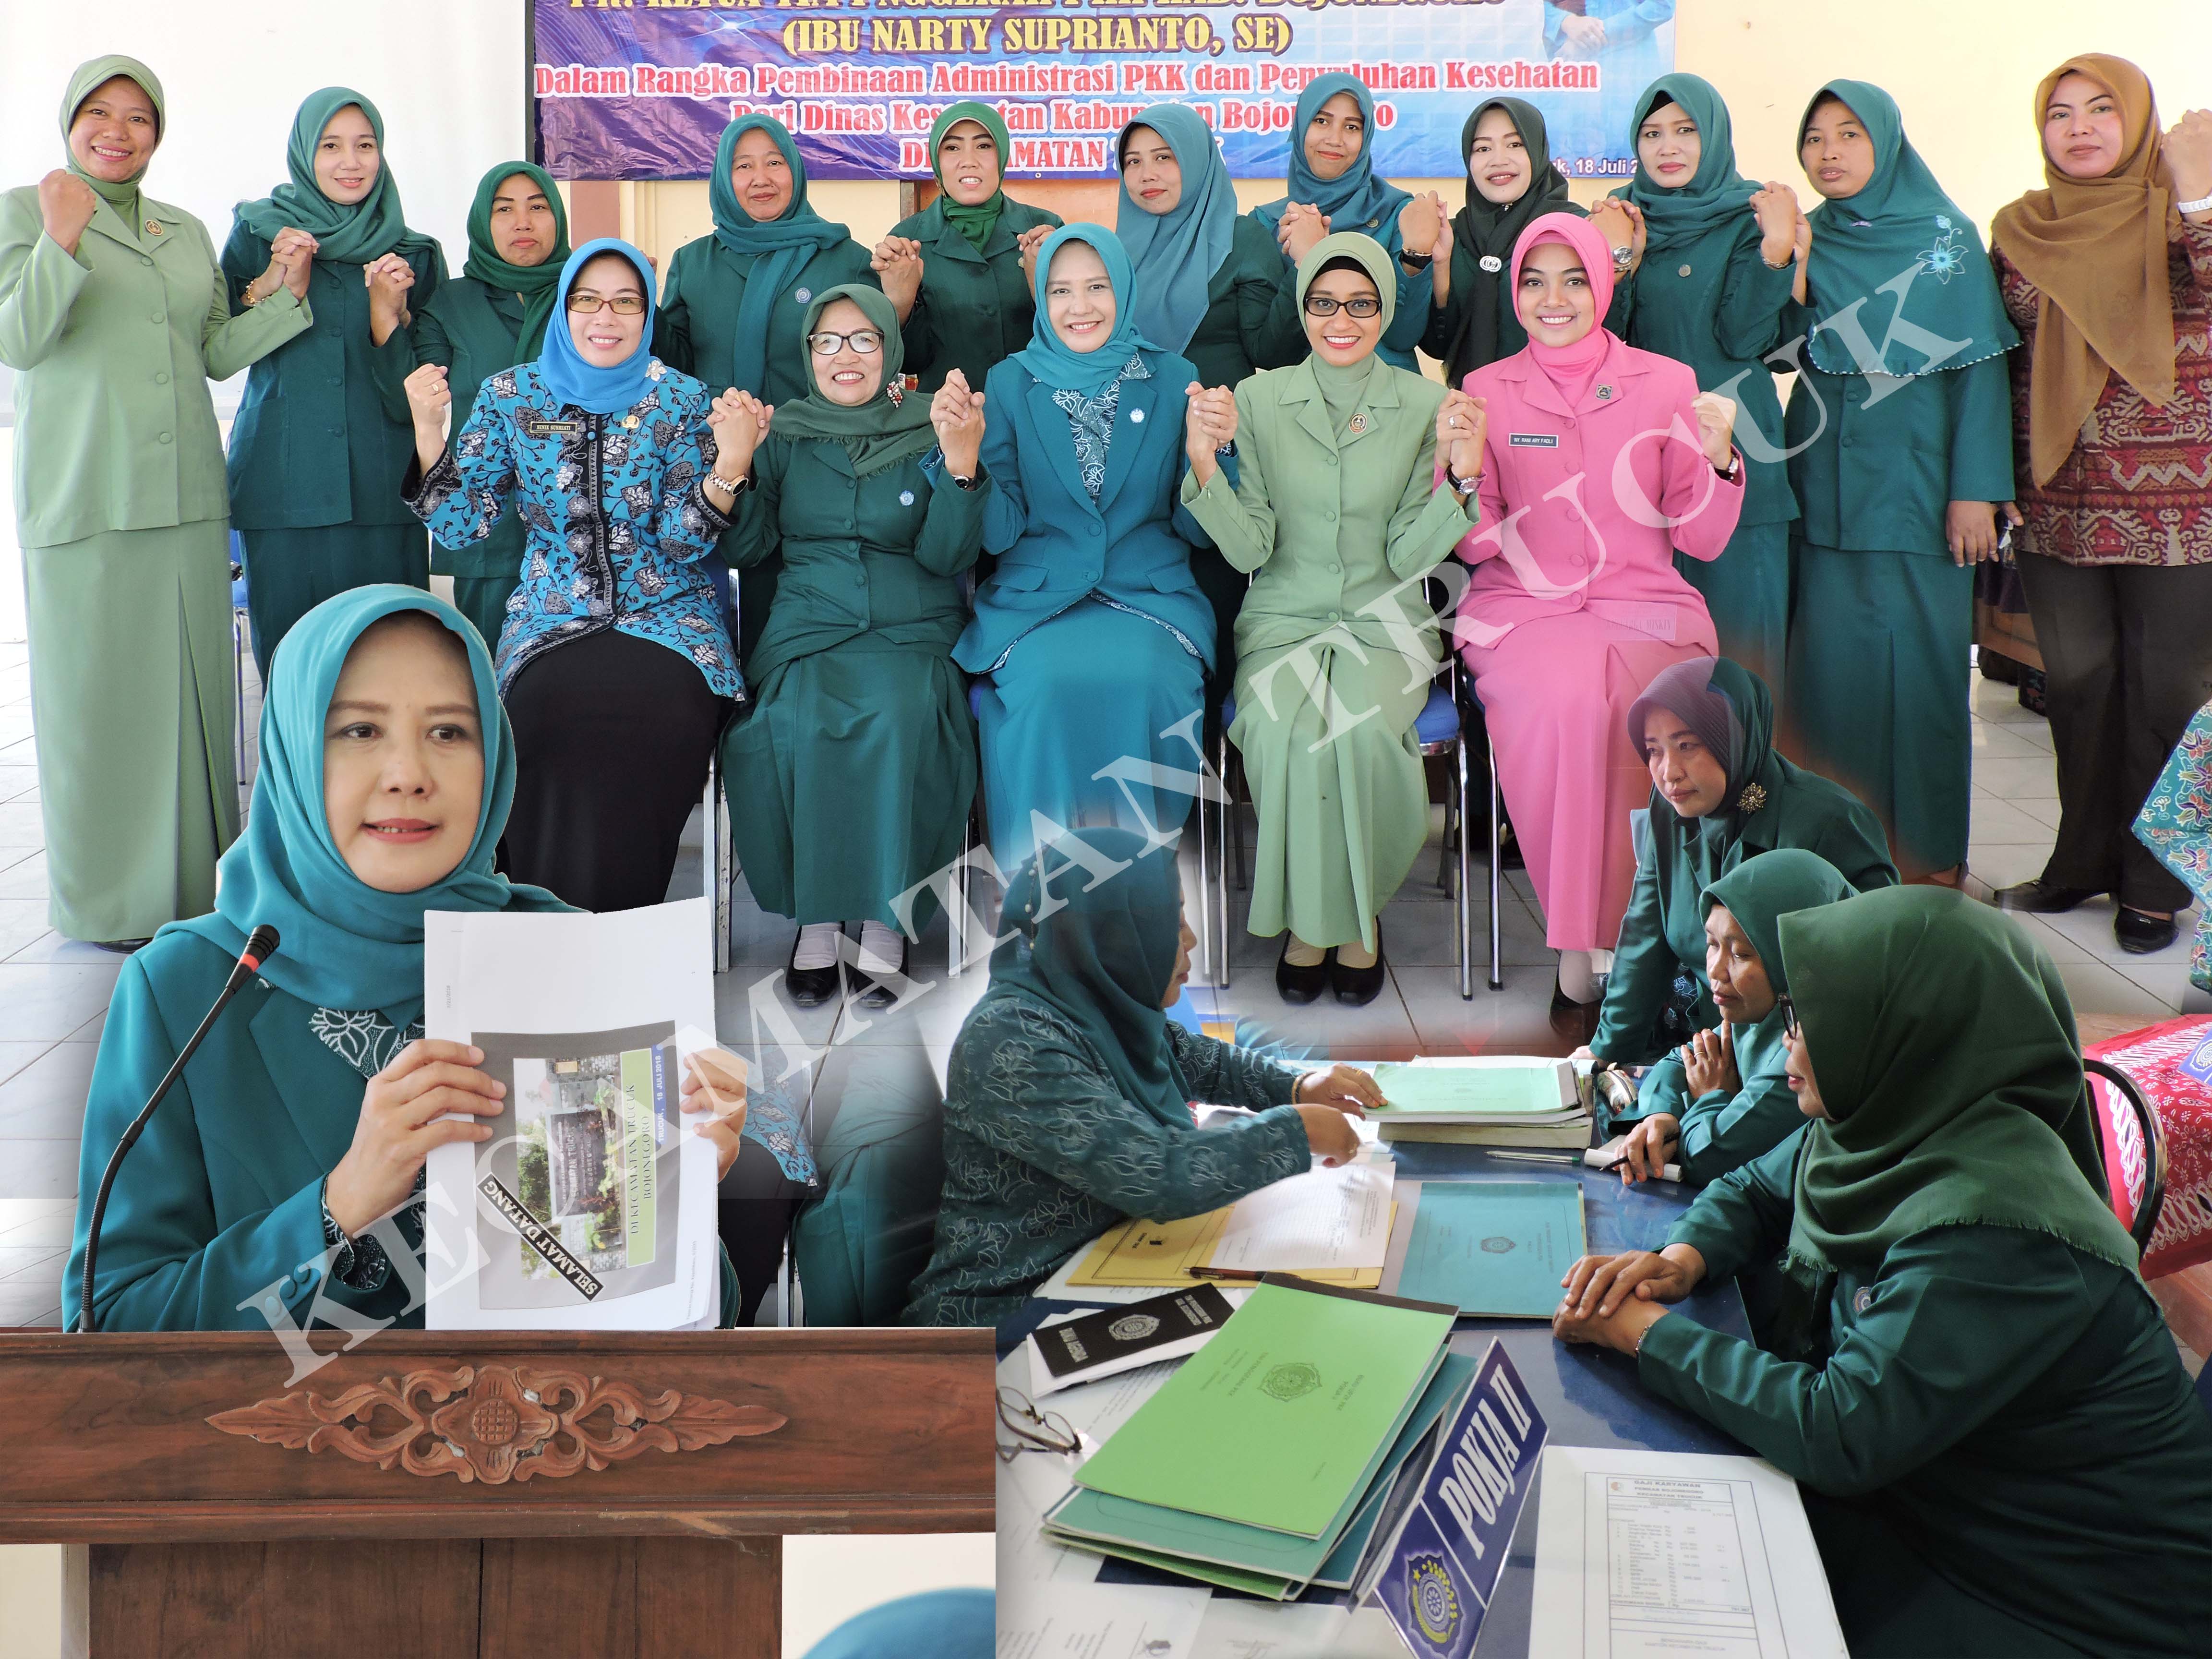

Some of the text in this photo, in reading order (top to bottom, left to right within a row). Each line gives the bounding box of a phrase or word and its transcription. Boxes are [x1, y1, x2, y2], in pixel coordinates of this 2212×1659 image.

[783, 16, 1290, 56] (IBU NARTY SUPRIANTO, SE)
[535, 67, 626, 94] Dalam
[636, 67, 749, 96] Rangka
[757, 66, 923, 93] Pembinaan
[932, 64, 1114, 92] Administrasi
[1123, 64, 1186, 91] PKK
[1194, 64, 1250, 91] dan
[1445, 60, 1598, 88] Kesehatan
[804, 104, 884, 131] Dinas
[893, 103, 1044, 131] Kestan
[1054, 102, 1213, 130] Kabun
[1223, 101, 1393, 132] Bojoo
[1575, 159, 1594, 174] 18
[1598, 159, 1626, 174] Juli
[657, 1092, 663, 1101] 18
[625, 1084, 639, 1234] DI KECAMATAN TRUCUK
[641, 1116, 653, 1200] BOJONEGORO
[483, 1180, 598, 1295] SELAMAT DATANG
[1438, 1363, 1532, 1560] POKJA II
